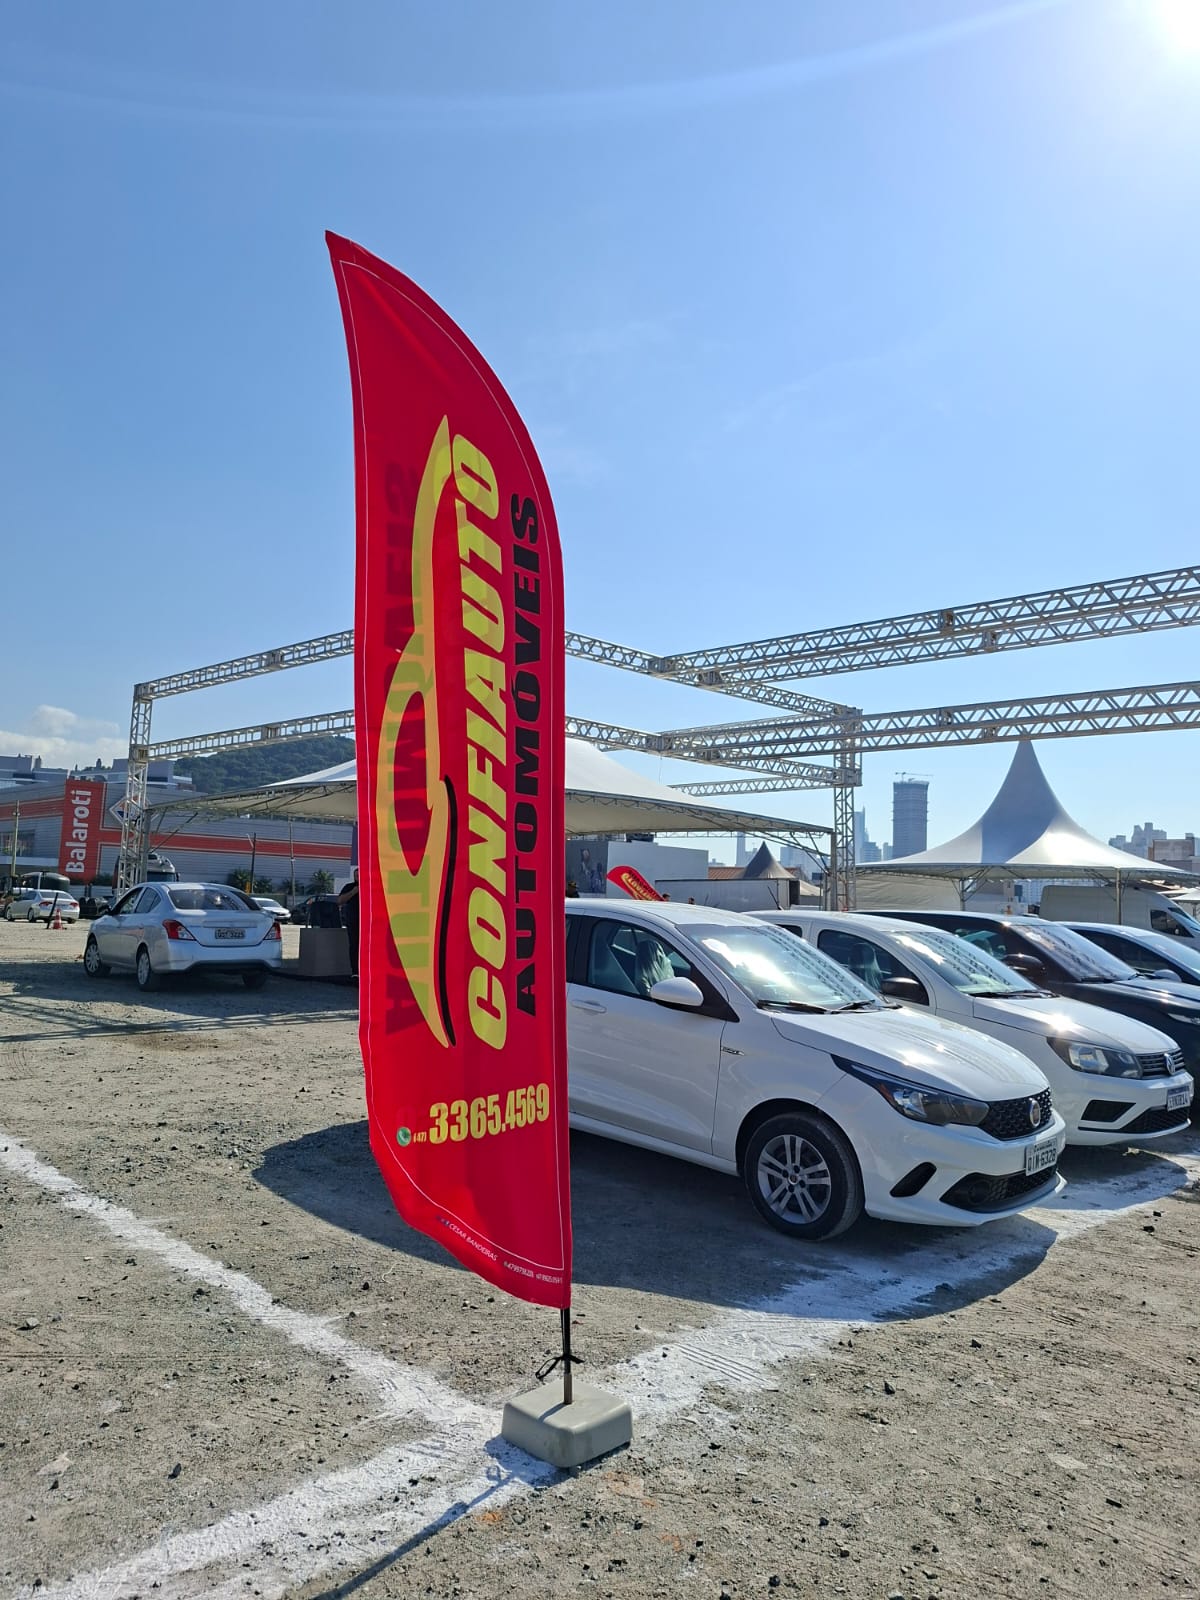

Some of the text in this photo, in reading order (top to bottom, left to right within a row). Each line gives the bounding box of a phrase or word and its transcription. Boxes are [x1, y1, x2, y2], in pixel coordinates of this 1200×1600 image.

[65, 789, 92, 873] Balaroti
[452, 433, 507, 1051] CONFIAUTO
[511, 492, 541, 1017] AUTOMÓVEIS
[429, 1082, 550, 1145] 3365.4569
